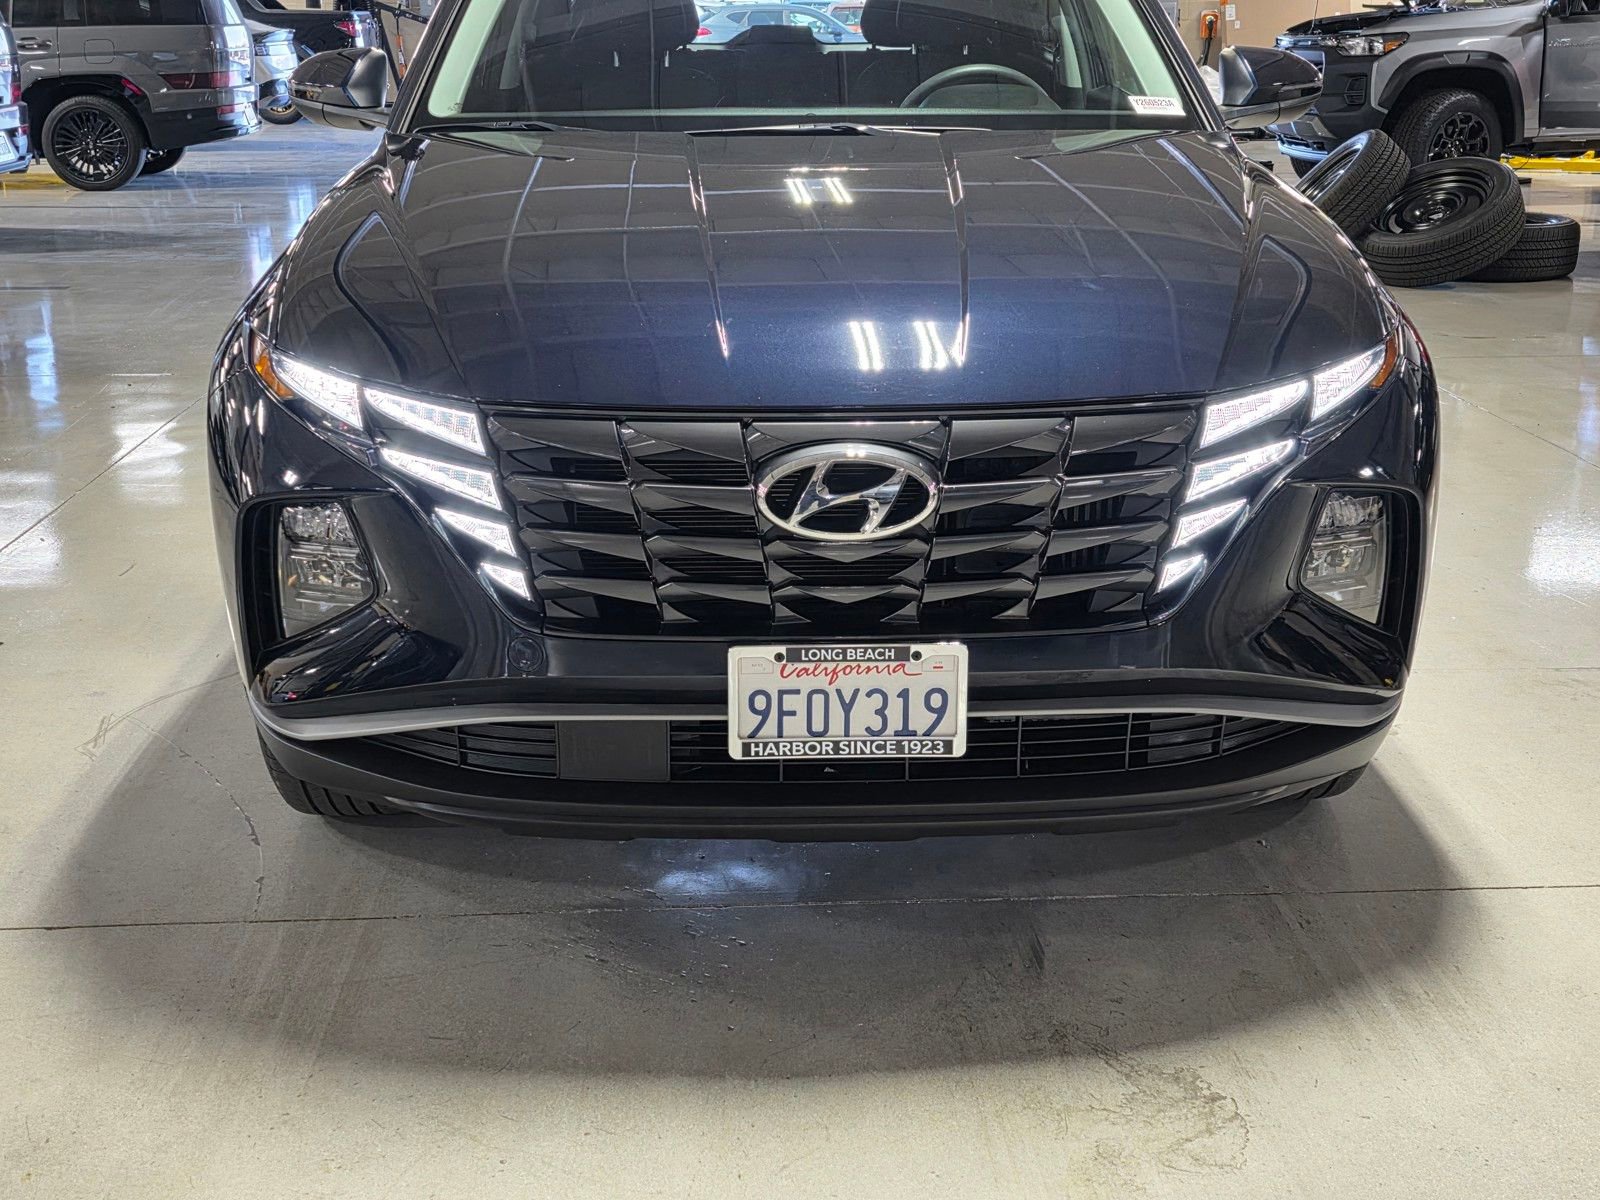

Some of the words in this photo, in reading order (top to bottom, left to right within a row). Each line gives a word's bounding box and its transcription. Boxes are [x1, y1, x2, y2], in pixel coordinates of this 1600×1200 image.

[801, 649, 843, 661] LONG
[847, 648, 895, 660] BEACH
[780, 662, 922, 685] California
[751, 742, 834, 756] HARBOR
[839, 741, 896, 755] SINCE
[902, 740, 944, 754] 1923
